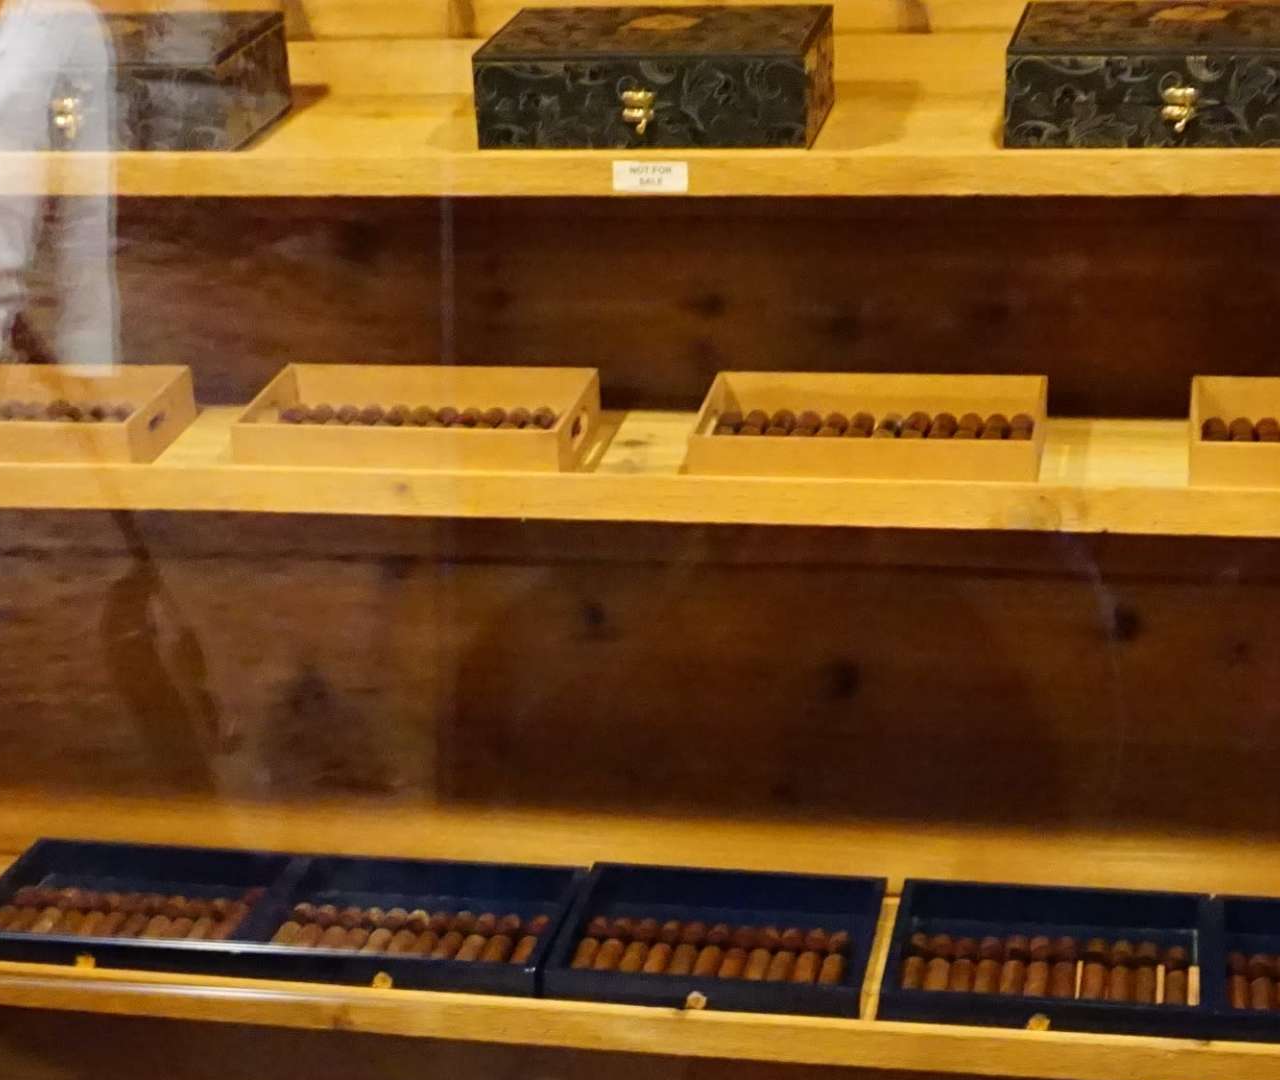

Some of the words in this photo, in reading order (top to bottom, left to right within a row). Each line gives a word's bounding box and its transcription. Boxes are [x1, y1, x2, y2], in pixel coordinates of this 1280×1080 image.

[629, 166, 649, 174] NOT
[652, 166, 672, 175] FOR
[639, 177, 663, 185] SALE
